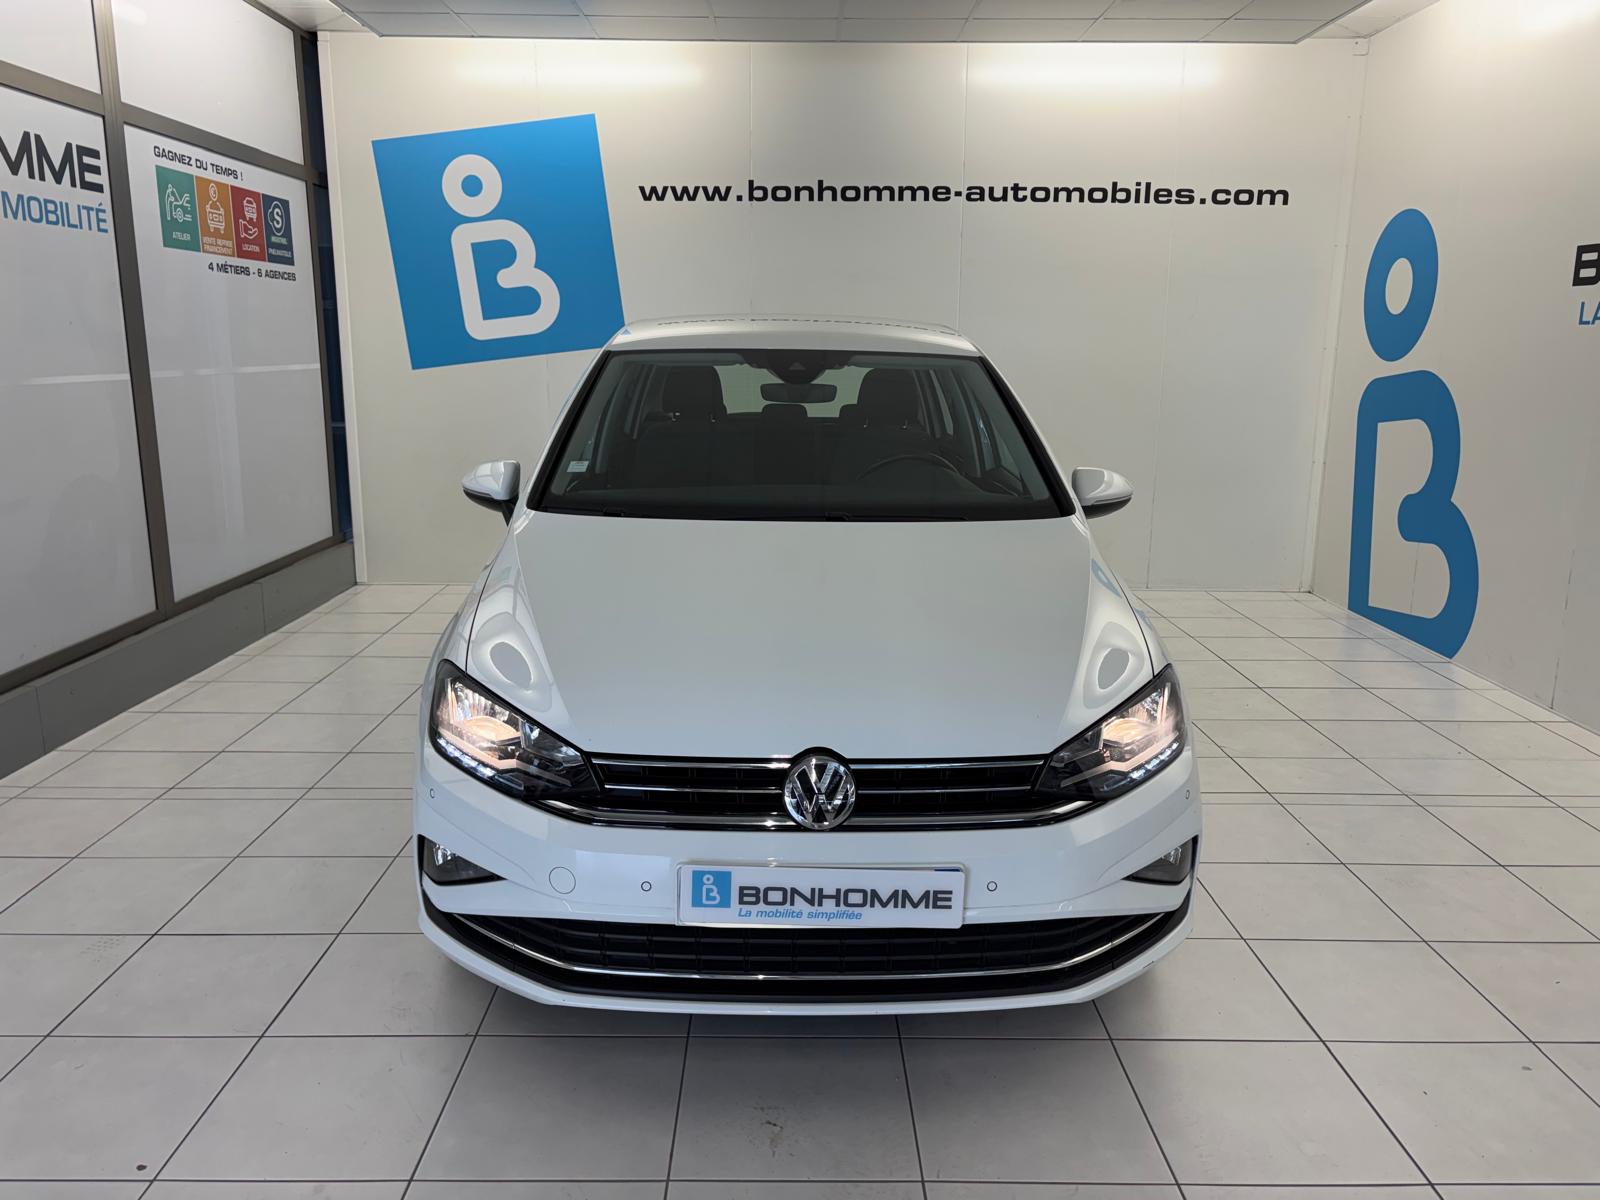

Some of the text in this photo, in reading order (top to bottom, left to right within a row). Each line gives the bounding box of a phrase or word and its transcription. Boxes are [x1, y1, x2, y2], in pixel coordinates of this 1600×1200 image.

[153, 145, 193, 167] GAGNEZ
[195, 158, 208, 171] DU
[210, 162, 239, 180] TEMPS
[638, 179, 1290, 206] www.bonhomme-automobiles.com
[1, 190, 109, 234] MOBILITÉ
[172, 231, 191, 241] ATELIER
[208, 261, 214, 272] 4
[216, 260, 251, 277] MÉTIERS
[257, 268, 262, 278] 6
[264, 269, 297, 282] AGENCES
[738, 885, 953, 910] BONHOMME
[738, 907, 863, 922] La mobilité simplifiée
